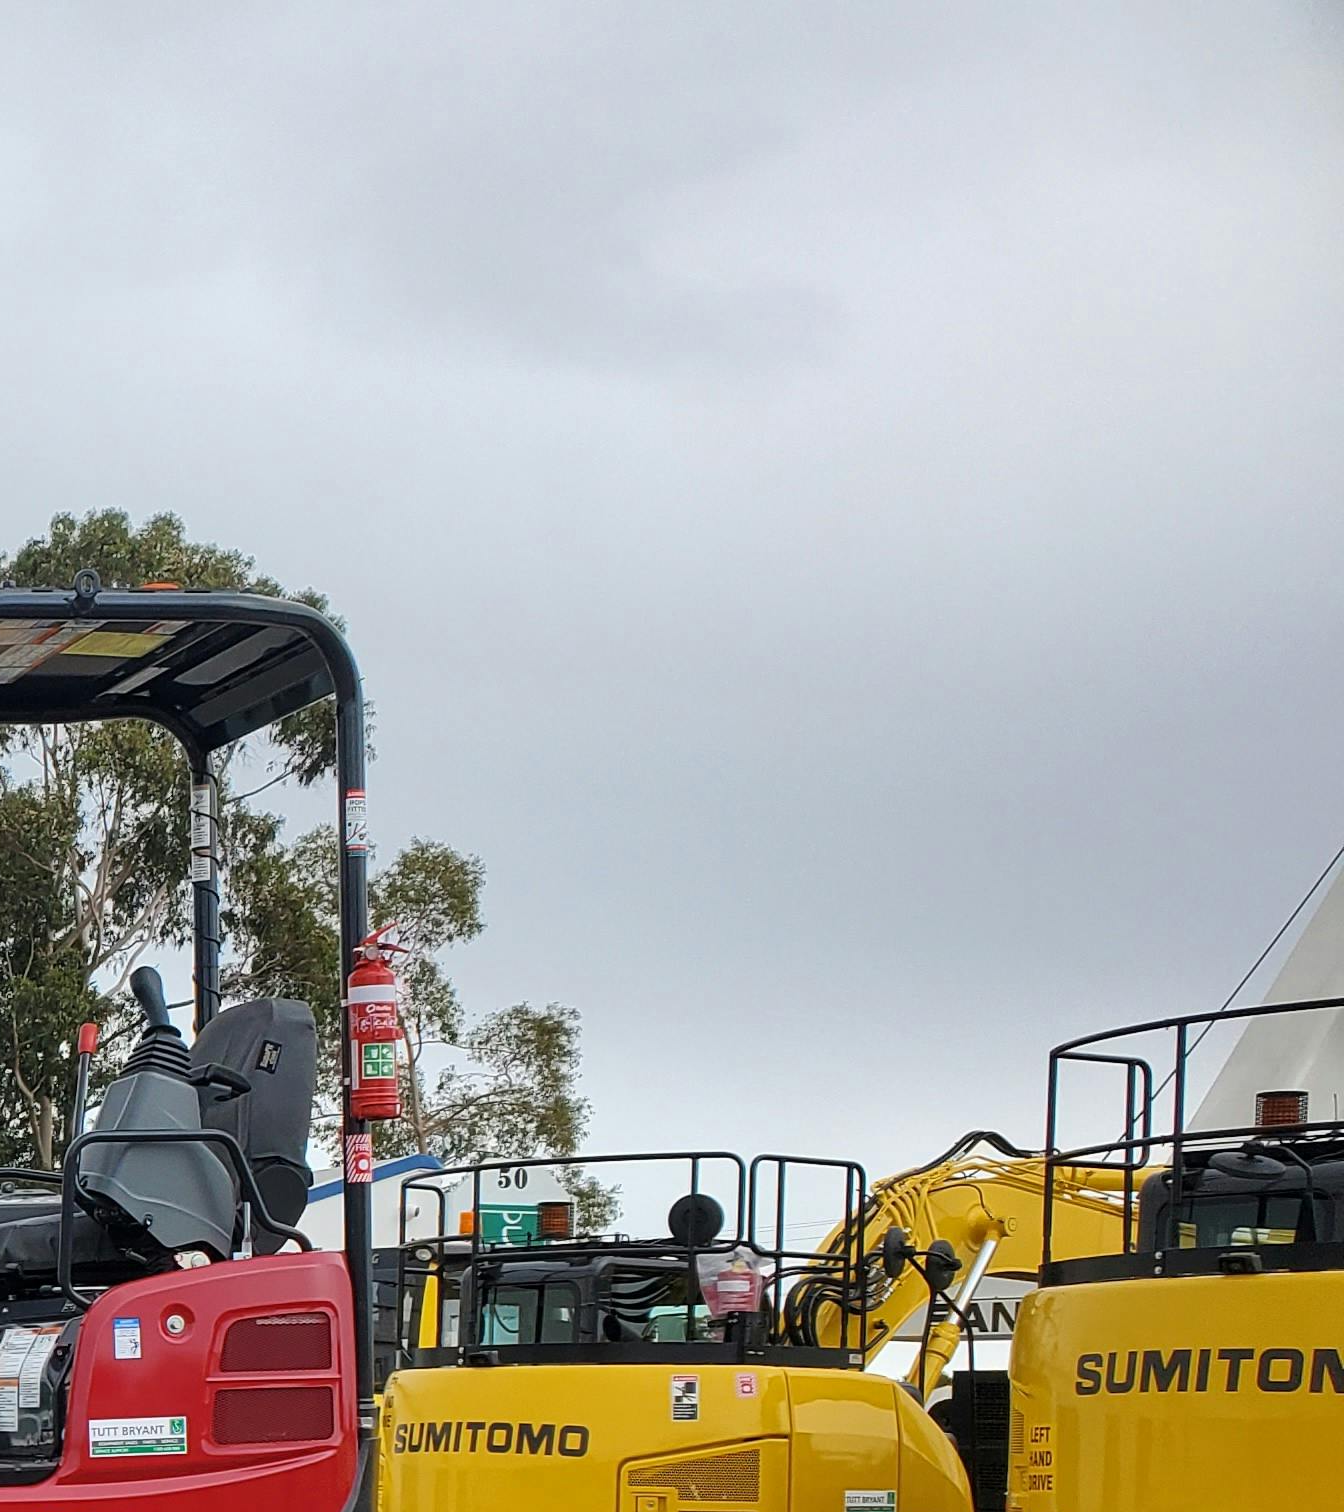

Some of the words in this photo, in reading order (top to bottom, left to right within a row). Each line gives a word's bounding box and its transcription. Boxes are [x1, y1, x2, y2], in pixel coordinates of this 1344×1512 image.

[497, 1168, 528, 1189] 50
[92, 1427, 118, 1437] TUTT
[122, 1425, 164, 1436] BRYANT
[394, 1421, 590, 1458] SUMITOMO
[1030, 1427, 1051, 1443] LEFT
